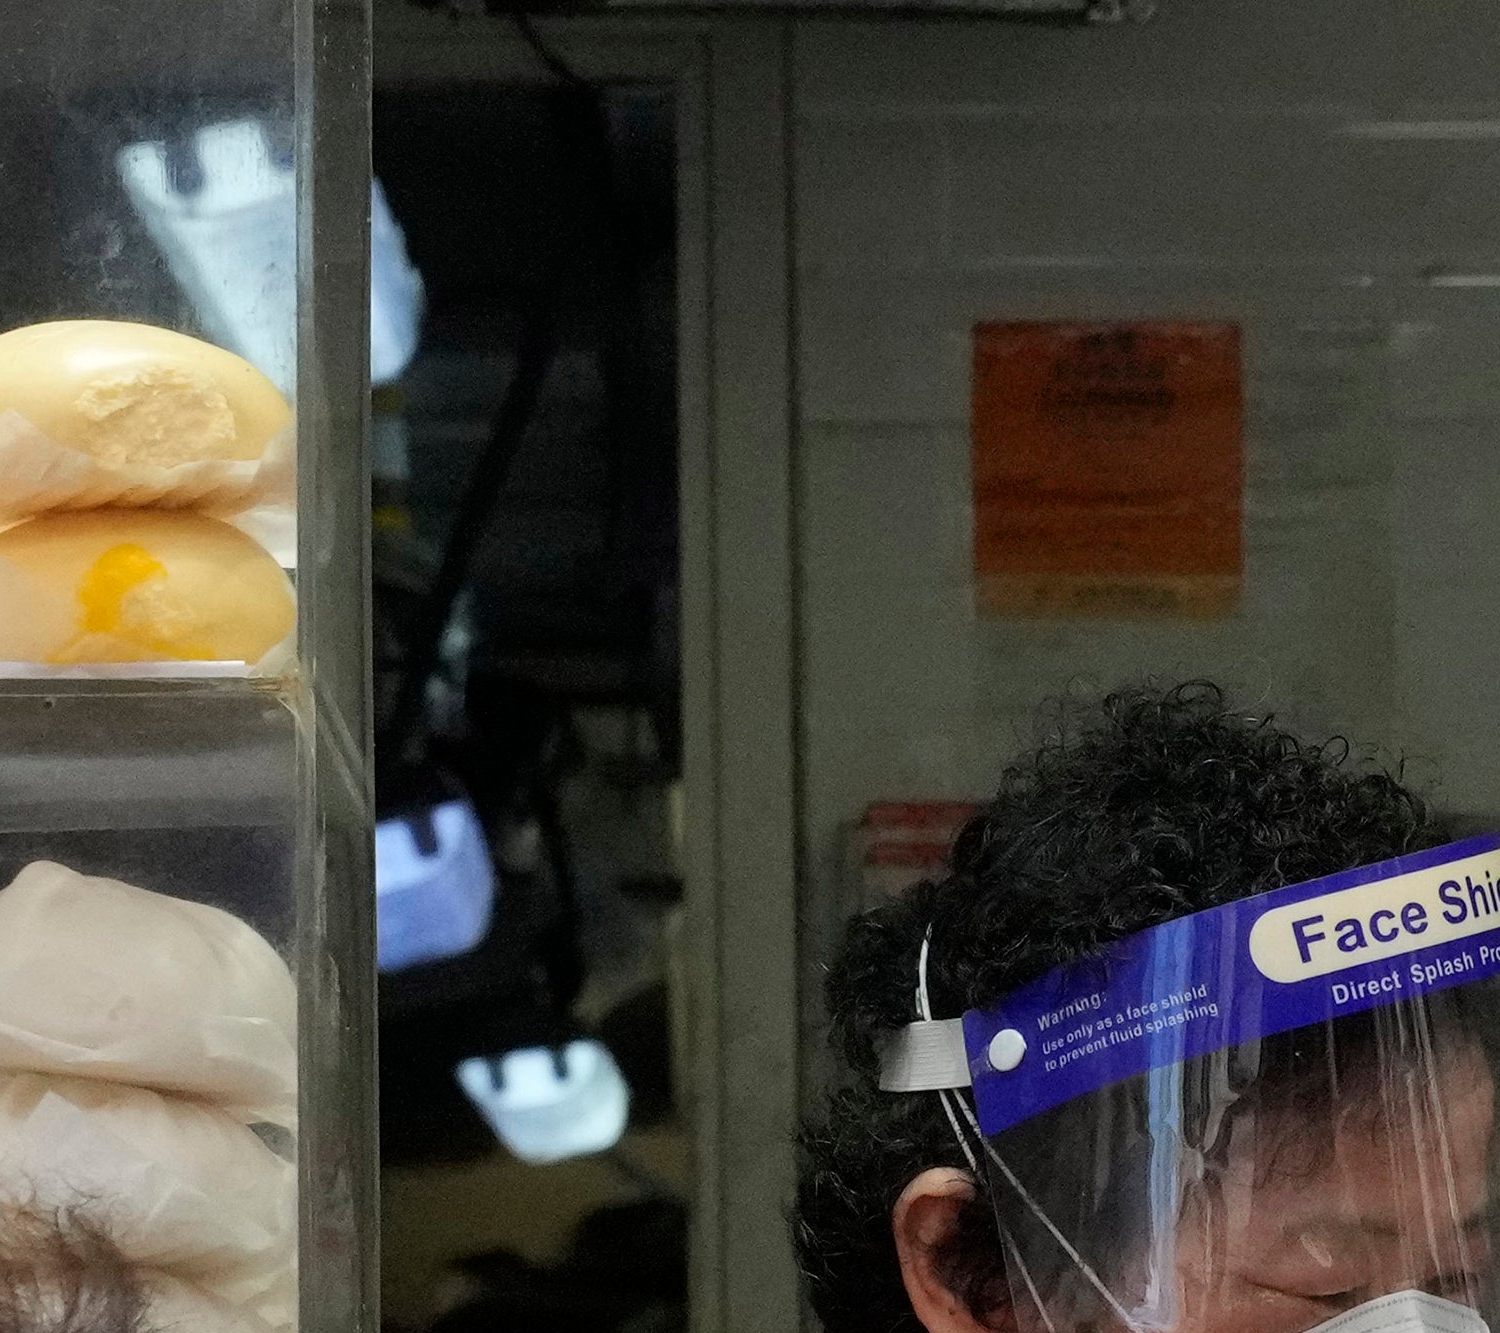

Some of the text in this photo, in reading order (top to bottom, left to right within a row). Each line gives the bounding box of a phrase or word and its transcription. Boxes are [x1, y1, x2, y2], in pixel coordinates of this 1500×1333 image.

[1291, 901, 1429, 964] Face
[1036, 990, 1107, 1032] Warning:
[1331, 970, 1402, 1005] Direct
[1410, 954, 1475, 986] Splash
[1041, 984, 1208, 1056] Use only as a face shield
[1044, 1002, 1219, 1073] to prevent fluid splashing
